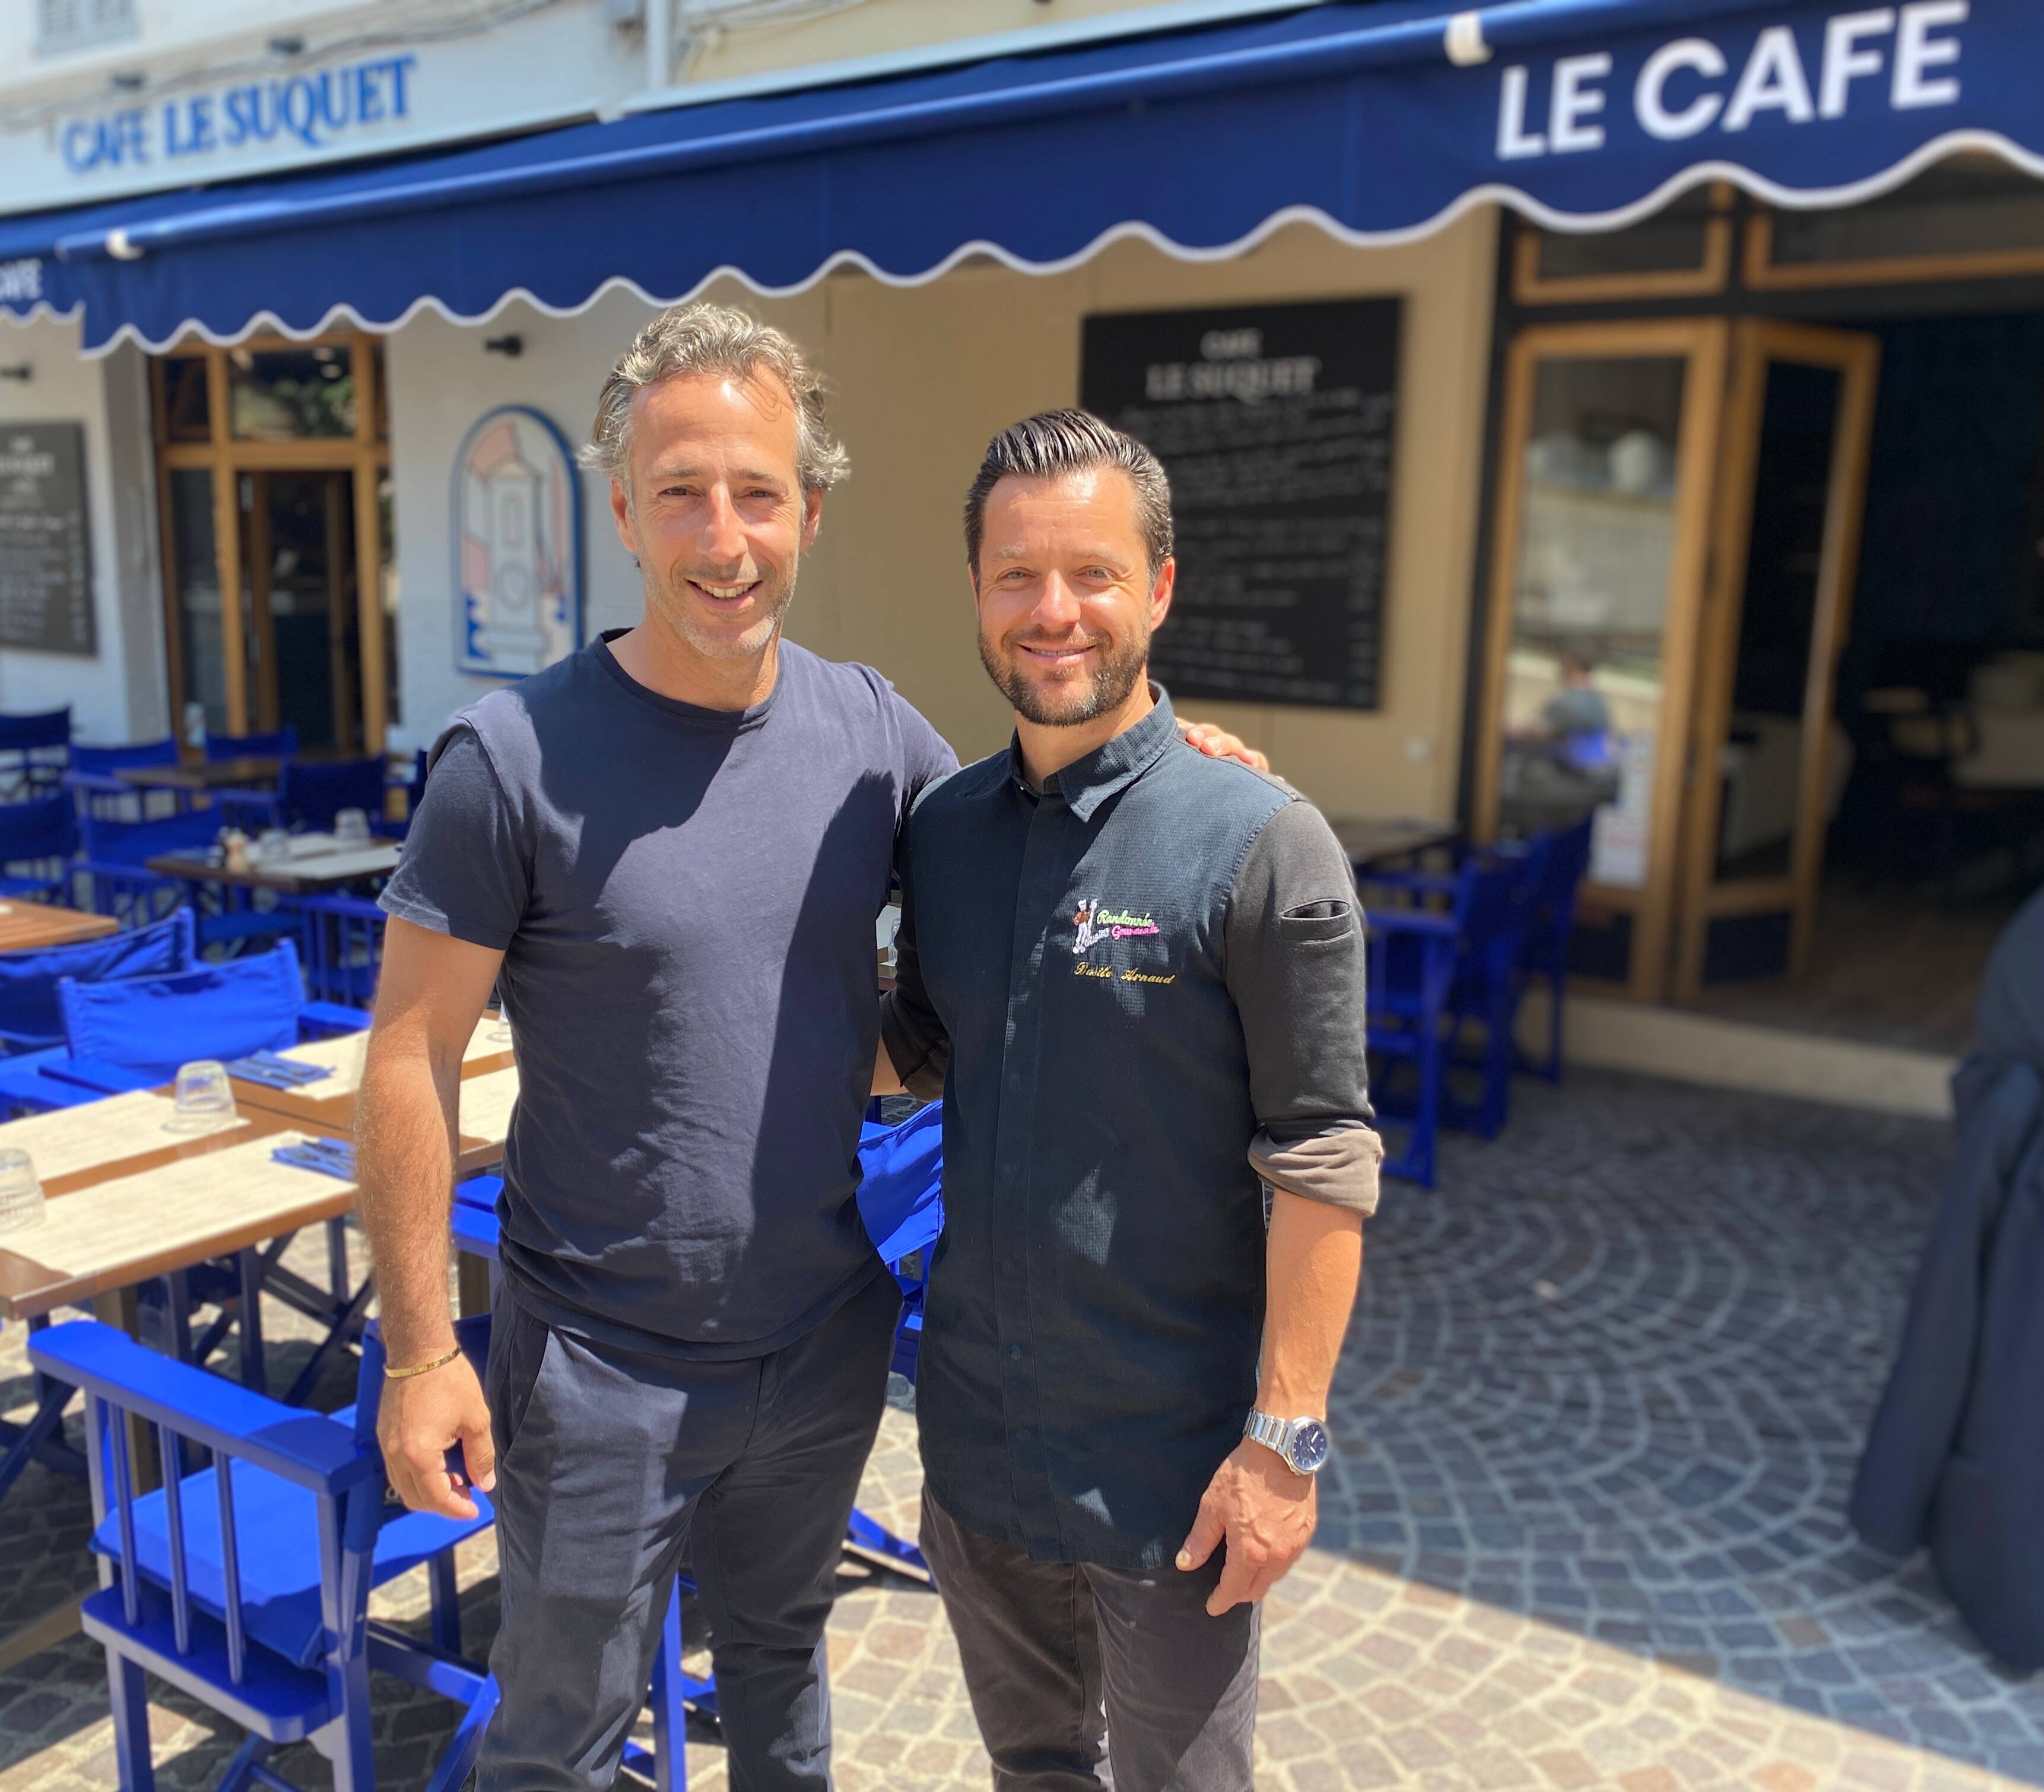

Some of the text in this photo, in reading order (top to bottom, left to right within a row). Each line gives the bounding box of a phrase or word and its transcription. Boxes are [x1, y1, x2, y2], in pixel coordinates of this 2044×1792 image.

[163, 95, 218, 157] LE
[224, 54, 417, 147] SUQUET
[1496, 0, 1970, 160] LE CAFE
[0, 259, 43, 300] AFE
[1121, 967, 1176, 984] Arnaud
